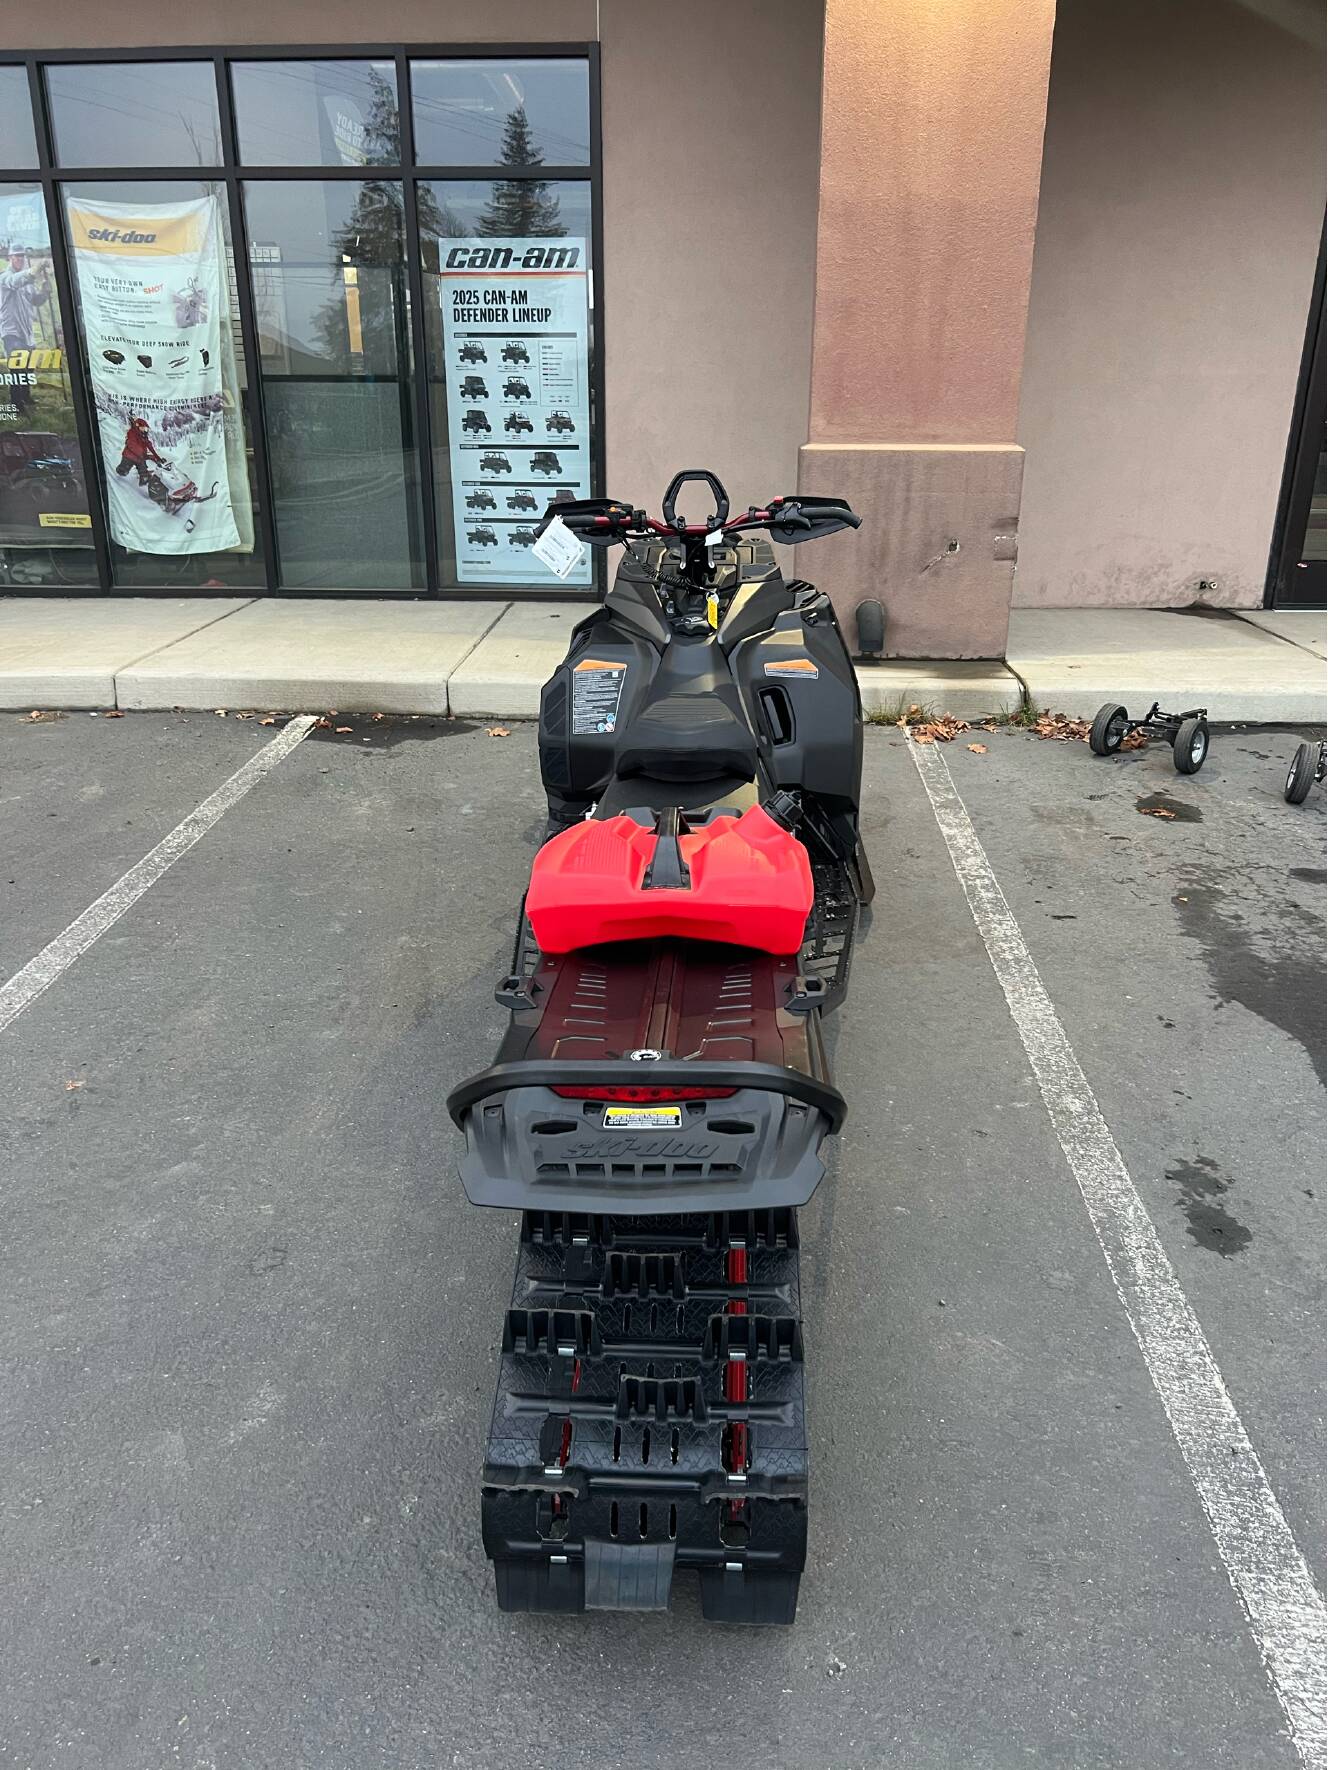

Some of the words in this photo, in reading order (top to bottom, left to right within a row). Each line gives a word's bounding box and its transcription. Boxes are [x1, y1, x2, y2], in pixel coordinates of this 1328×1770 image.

[88, 228, 157, 244] ski-doo
[445, 247, 580, 269] can-am
[143, 283, 164, 295] SHOT
[452, 289, 480, 305] 2025
[483, 289, 528, 305] CAN-AM
[453, 307, 509, 323] DEFENDER
[512, 307, 552, 323] LINEUP
